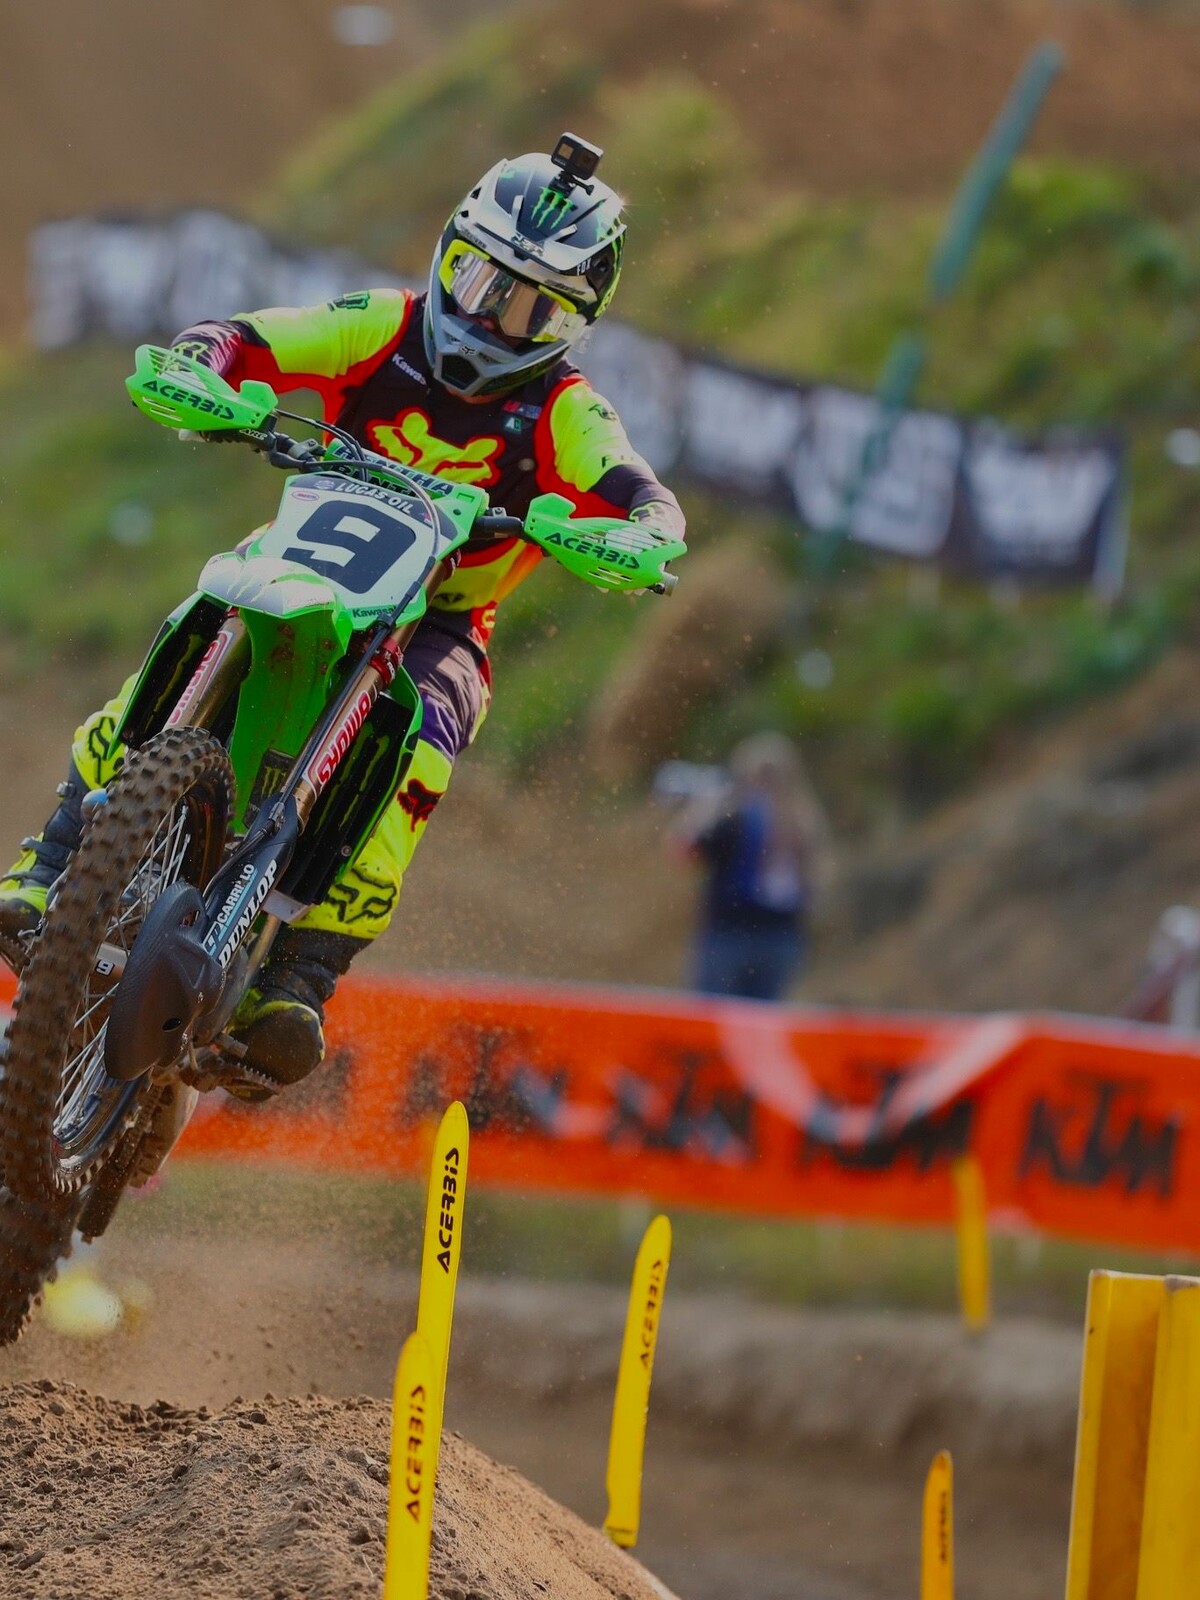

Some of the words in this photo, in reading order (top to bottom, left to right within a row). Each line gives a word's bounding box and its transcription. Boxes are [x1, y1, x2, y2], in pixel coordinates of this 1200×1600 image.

[576, 257, 591, 276] FOX
[392, 353, 428, 388] Kawas
[333, 444, 455, 495] RENTHA
[335, 481, 387, 499] LUCAS
[388, 495, 414, 515] OIL
[281, 500, 417, 595] 9
[352, 606, 398, 619] Kawasa
[316, 689, 372, 786] SHOWA
[218, 858, 278, 969] DUNLOP
